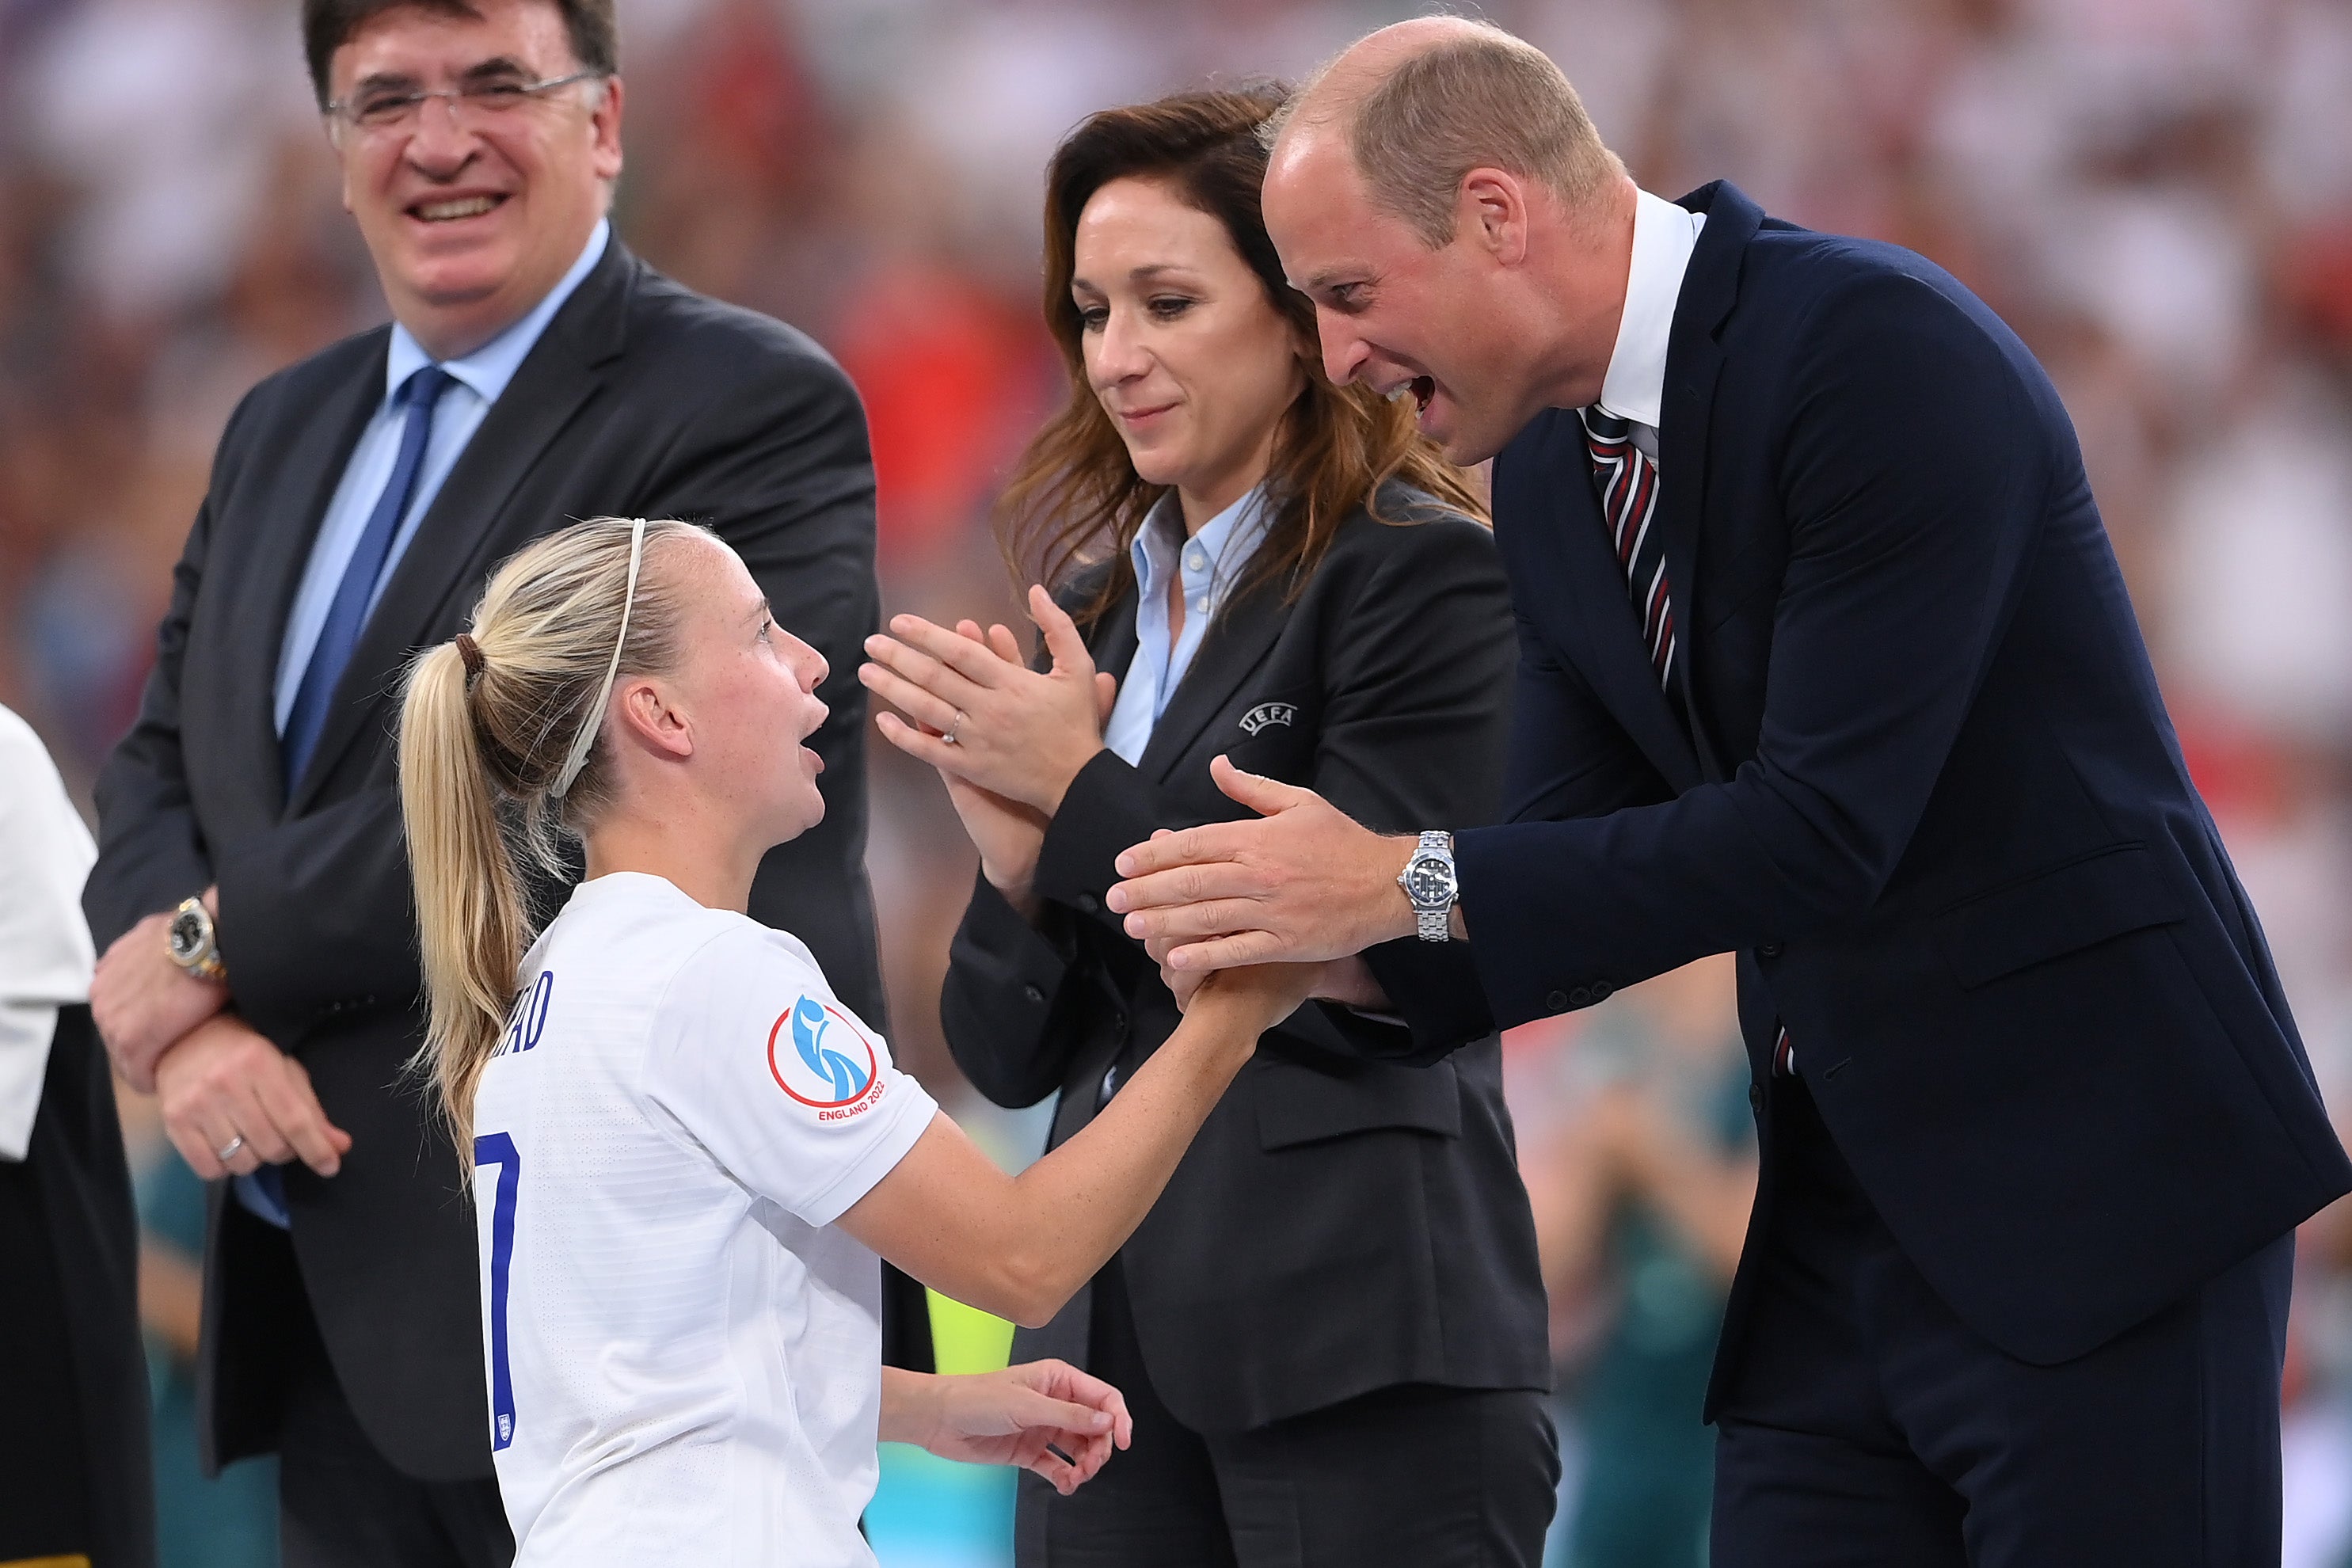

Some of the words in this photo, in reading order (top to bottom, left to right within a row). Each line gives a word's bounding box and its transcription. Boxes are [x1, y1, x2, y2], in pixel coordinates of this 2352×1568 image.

[1242, 706, 1292, 733] UEFA
[818, 1101, 869, 1121] ENGLAND
[867, 1080, 885, 1105] 2022
